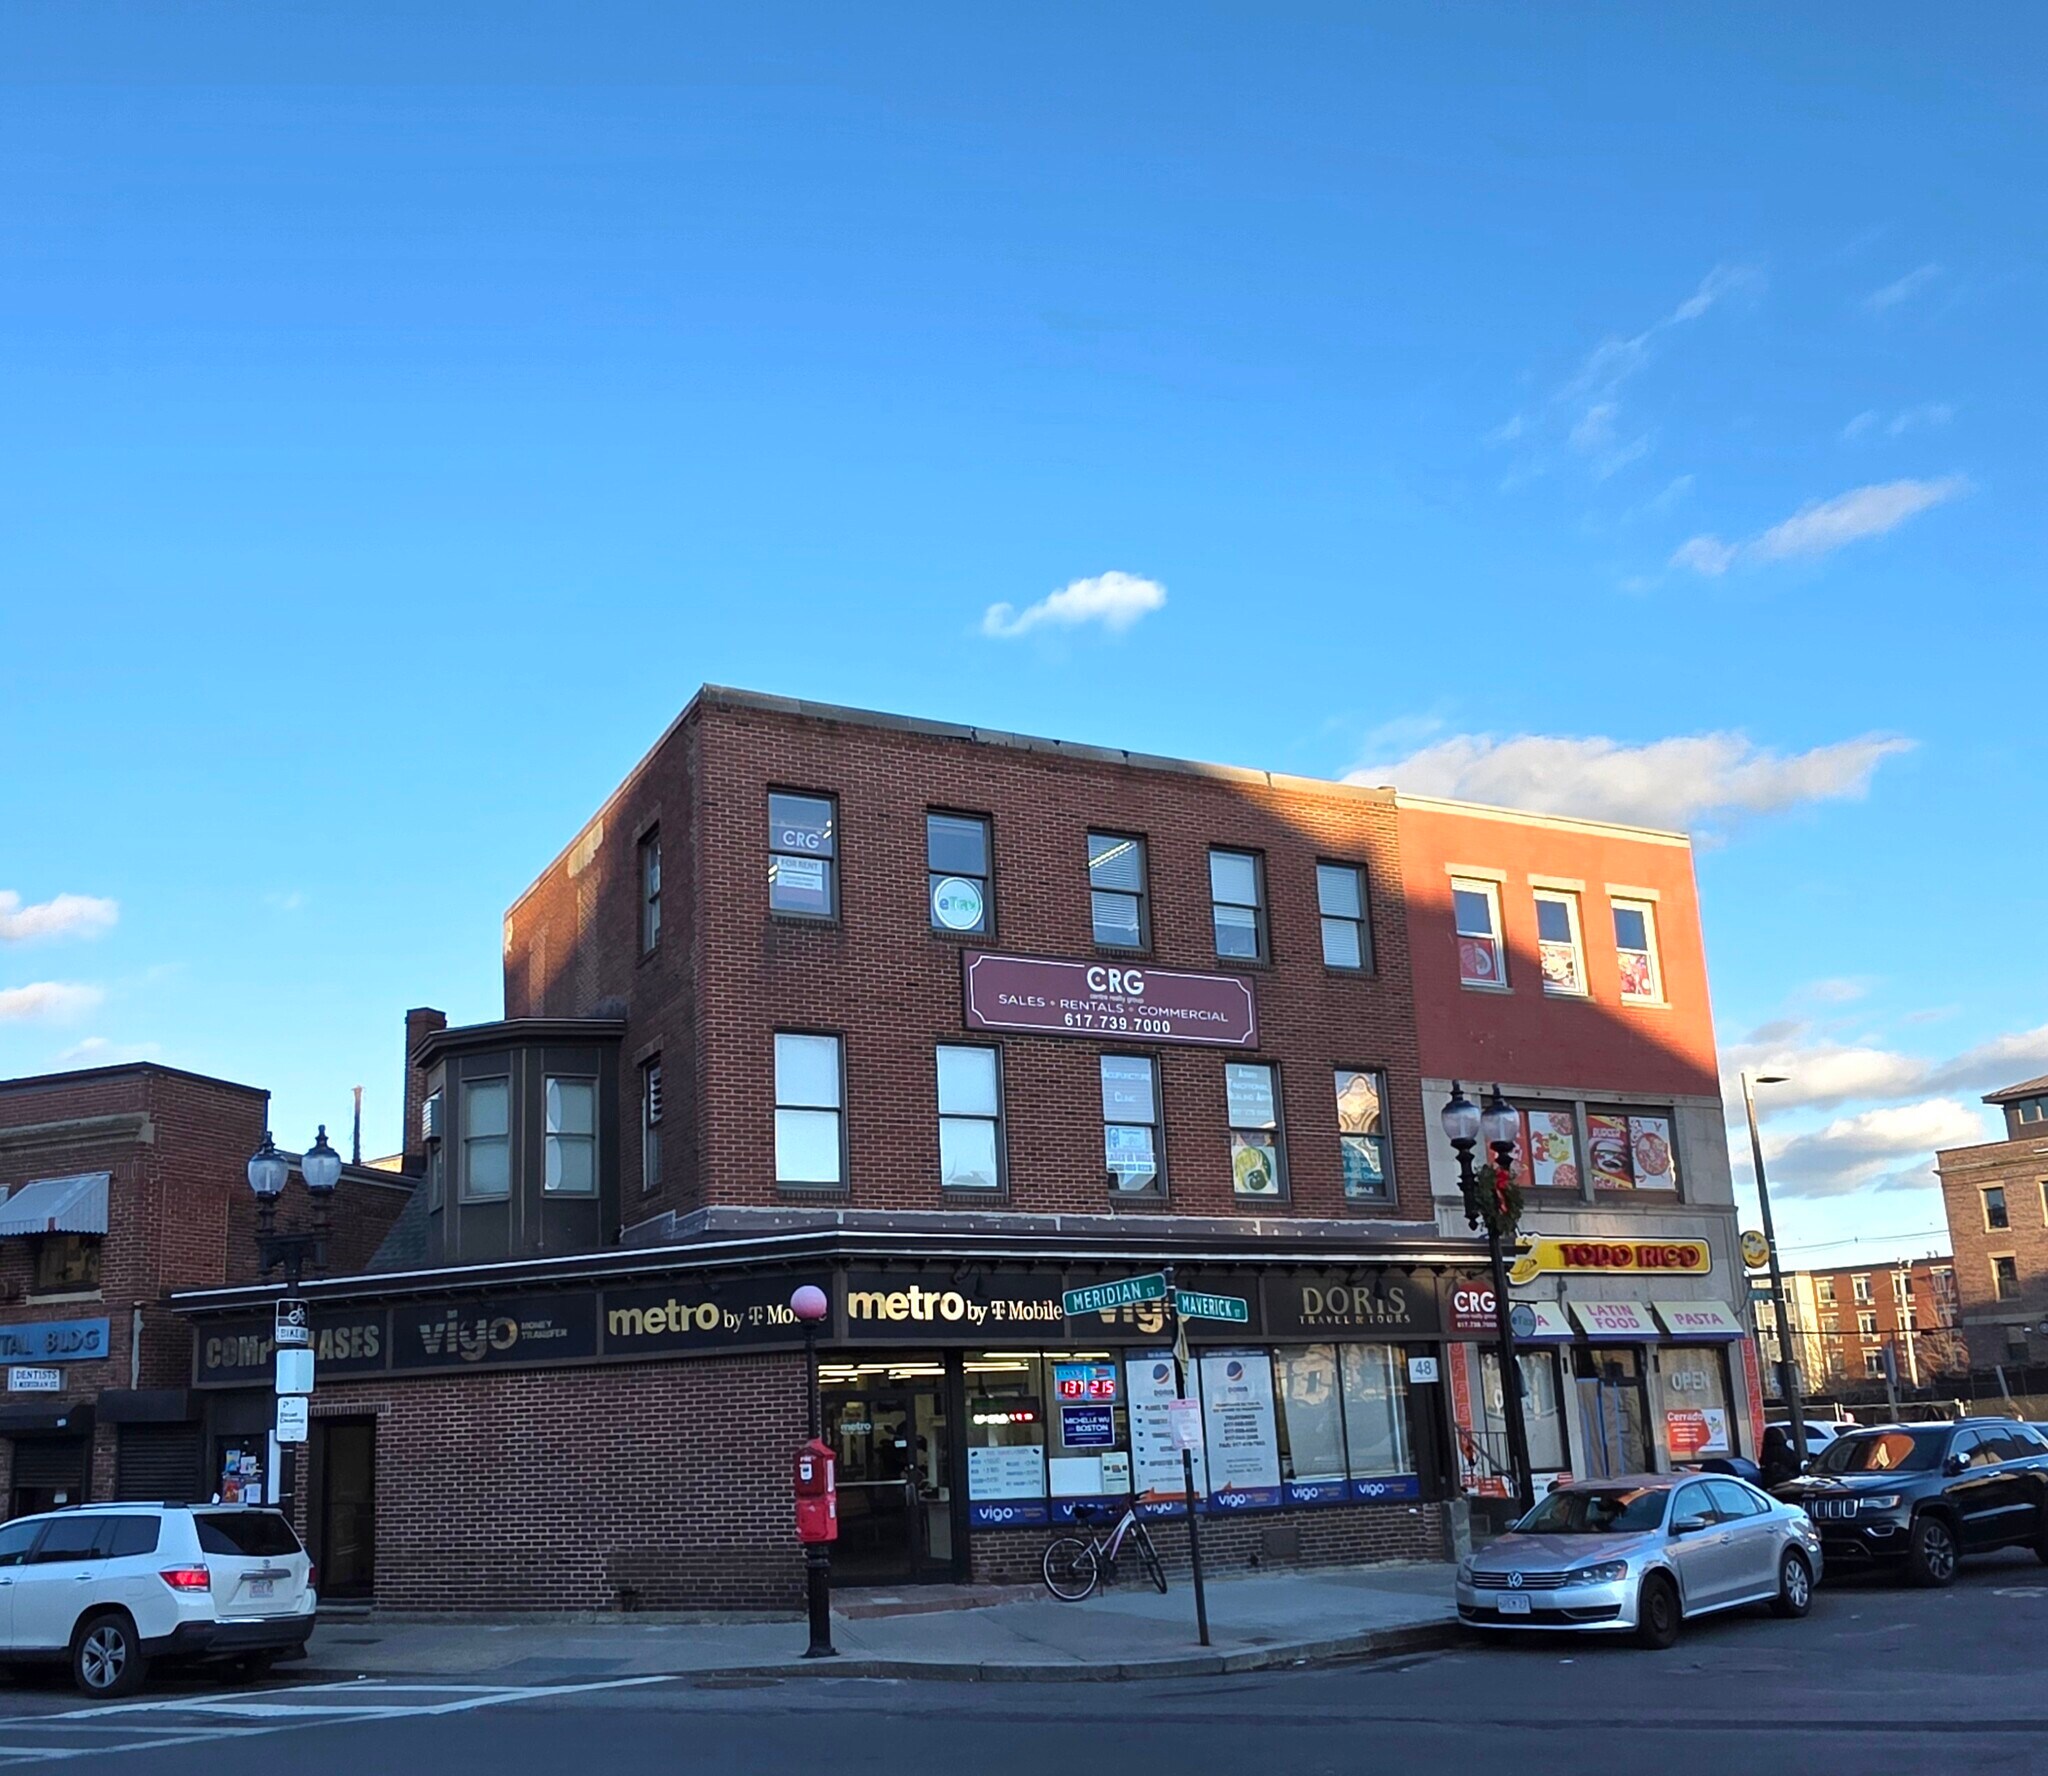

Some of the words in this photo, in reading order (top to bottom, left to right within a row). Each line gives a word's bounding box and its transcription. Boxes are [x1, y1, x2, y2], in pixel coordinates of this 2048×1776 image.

[783, 830, 819, 849] CRG
[1086, 966, 1145, 995] CRG
[998, 993, 1046, 1007] SALES
[1060, 999, 1125, 1014] RENTALS
[1138, 1005, 1229, 1022] COMMERCIAL
[1559, 1243, 1633, 1268] TODO
[1635, 1244, 1701, 1268] RICO
[848, 1285, 964, 1321] metro
[966, 1300, 988, 1325] by
[1072, 1282, 1142, 1311] MERIDIAN
[1146, 1286, 1155, 1297] ST
[1302, 1286, 1406, 1315] DORIS
[1454, 1291, 1496, 1312] CRG
[1181, 1295, 1232, 1317] MAVERICK
[1586, 1304, 1634, 1317] LATIN
[521, 1320, 552, 1329] MONEY
[608, 1298, 720, 1336] metro
[723, 1309, 744, 1333] by
[1299, 1315, 1351, 1325] TRAVEL
[1369, 1314, 1411, 1324] TOURS
[1595, 1316, 1641, 1329] FOOD
[1674, 1313, 1725, 1326] PASTA
[45, 1328, 100, 1354] BLDG
[419, 1309, 518, 1361] vigo
[522, 1328, 568, 1339] TRANSFER
[16, 1370, 58, 1380] DENTISTS
[1415, 1360, 1432, 1376] 48
[1064, 1380, 1084, 1394] 137
[1090, 1380, 1114, 1394] 215
[1672, 1370, 1711, 1391] OPEN
[1667, 1411, 1704, 1422] Cerrado
[840, 1422, 872, 1431] metro
[1075, 1424, 1109, 1432] BOSTON
[1292, 1485, 1318, 1500] vigo
[1359, 1482, 1385, 1496] vigo
[1218, 1490, 1246, 1507] vigo
[979, 1503, 1014, 1521] vigo
